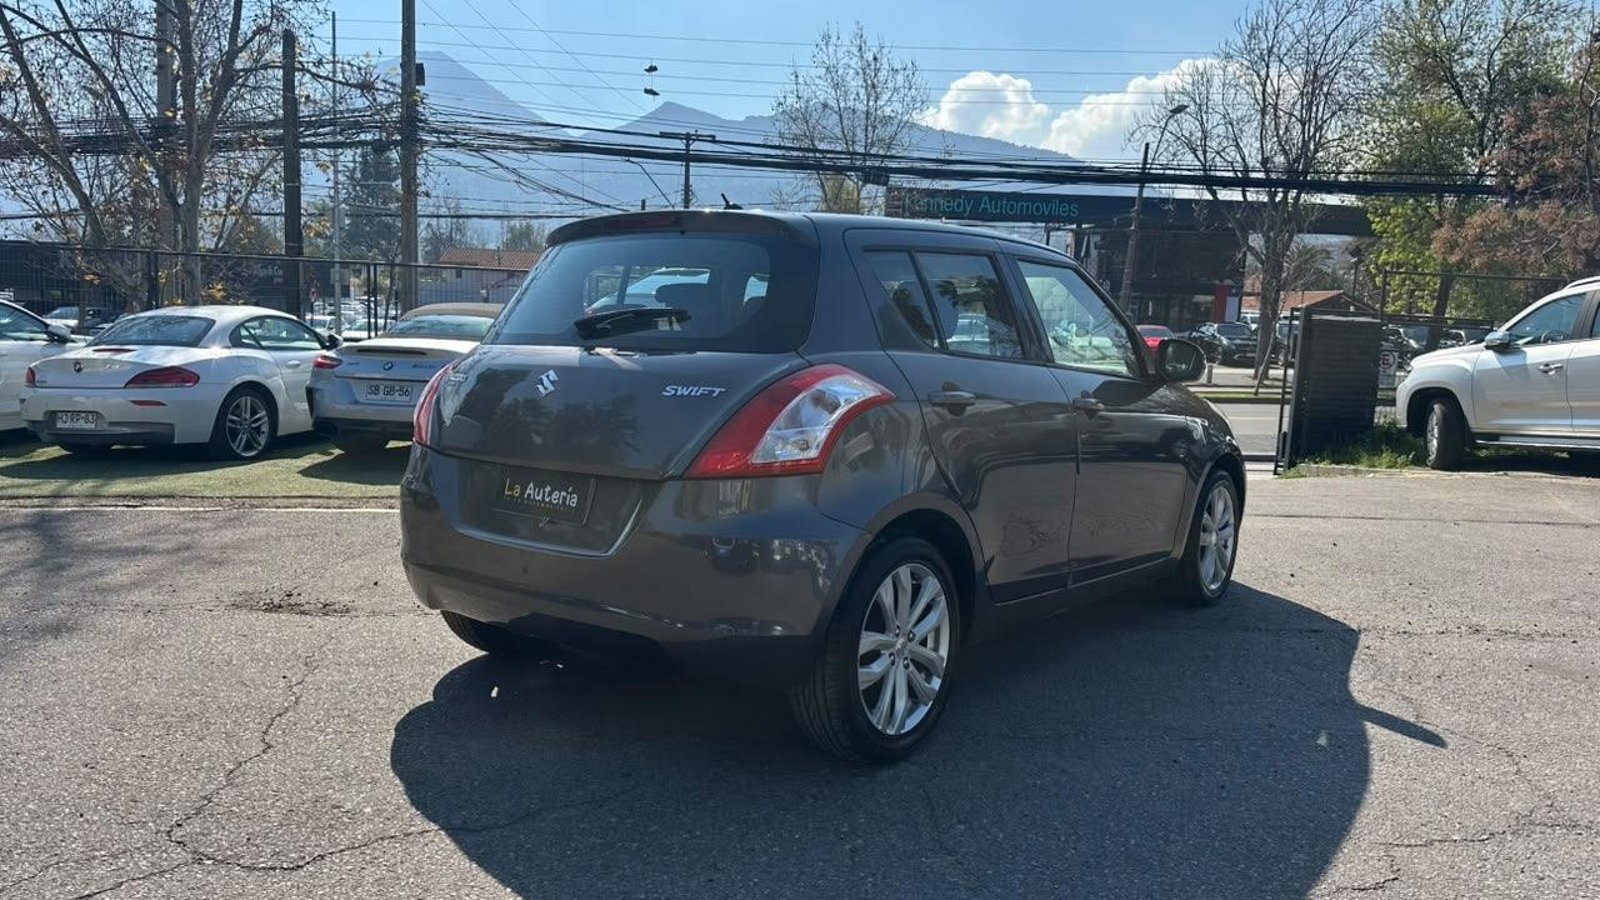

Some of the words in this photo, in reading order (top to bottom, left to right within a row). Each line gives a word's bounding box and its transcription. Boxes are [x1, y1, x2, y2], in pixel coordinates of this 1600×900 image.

[905, 195, 973, 216] Kennedy
[979, 195, 1080, 217] Automoviles
[662, 385, 726, 397] SWIFT
[504, 478, 520, 497] La
[524, 481, 578, 507] Autería
